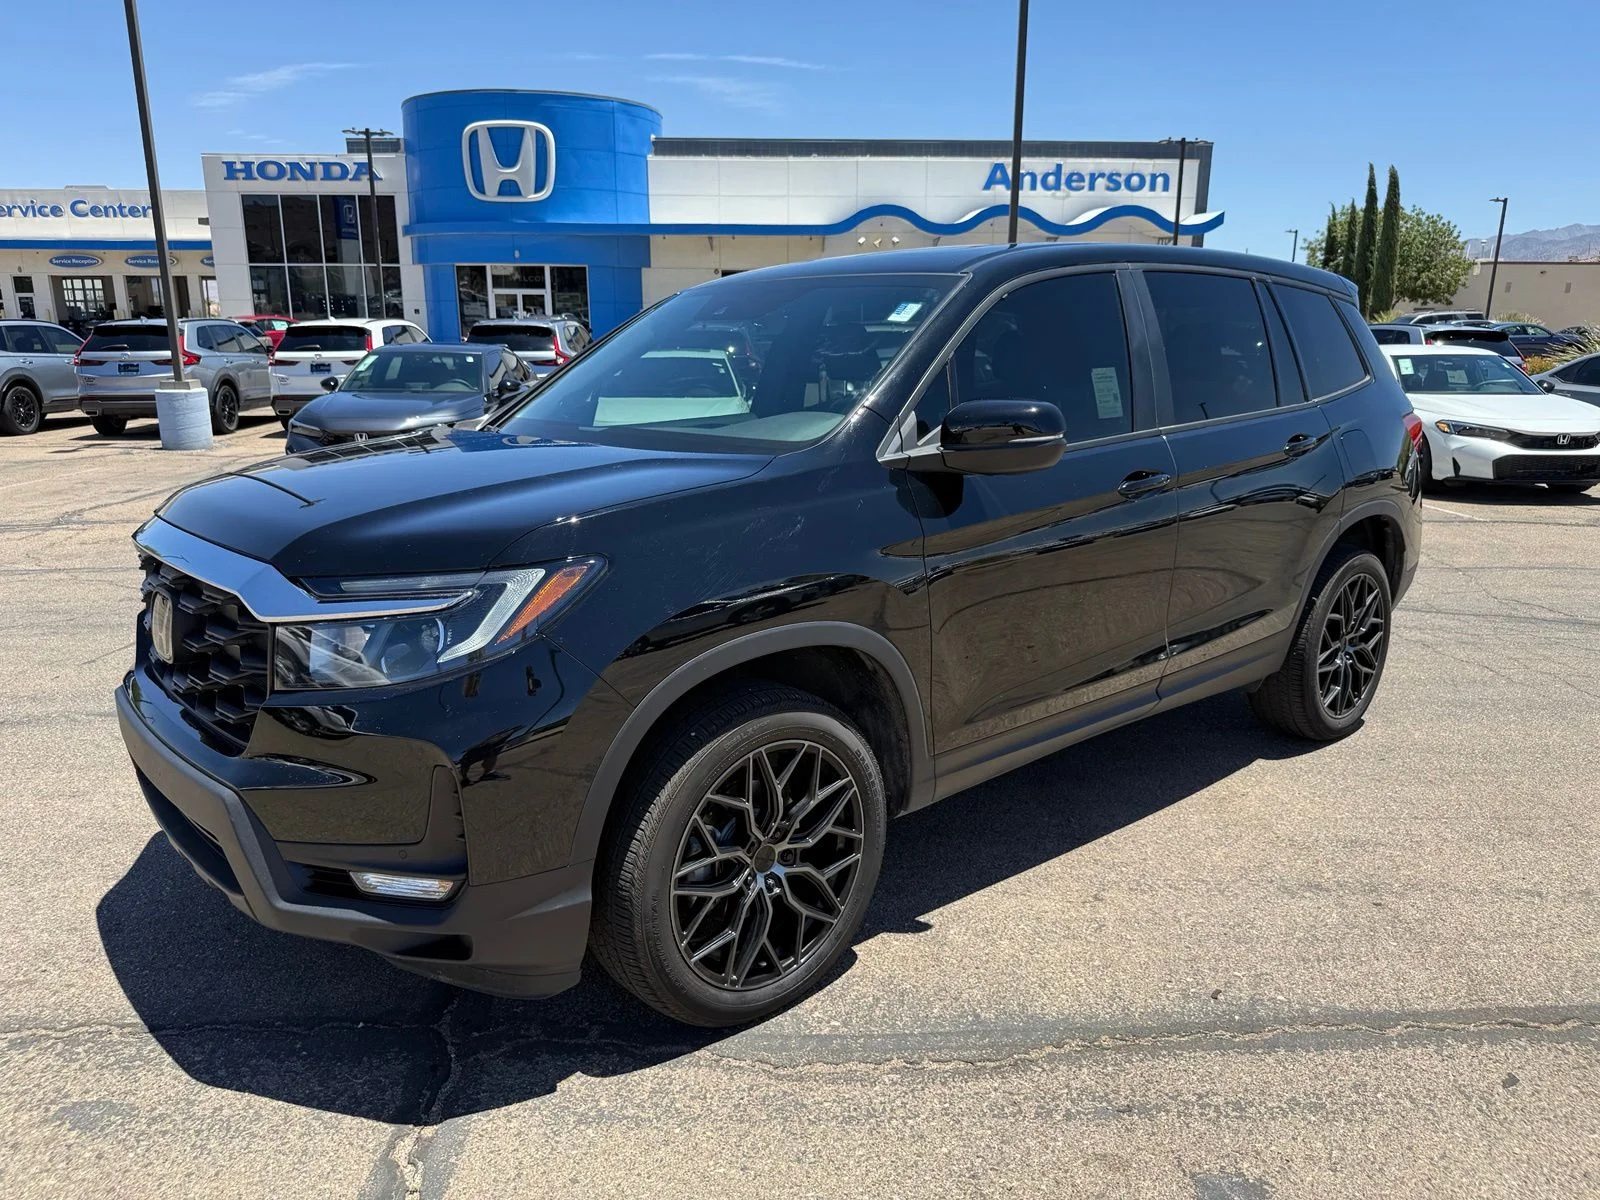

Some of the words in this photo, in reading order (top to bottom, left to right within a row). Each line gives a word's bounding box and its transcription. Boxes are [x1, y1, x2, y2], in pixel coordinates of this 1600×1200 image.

[222, 160, 383, 181] HONDA
[982, 162, 1170, 192] Anderson
[0, 199, 64, 217] ervice
[70, 199, 152, 217] Center
